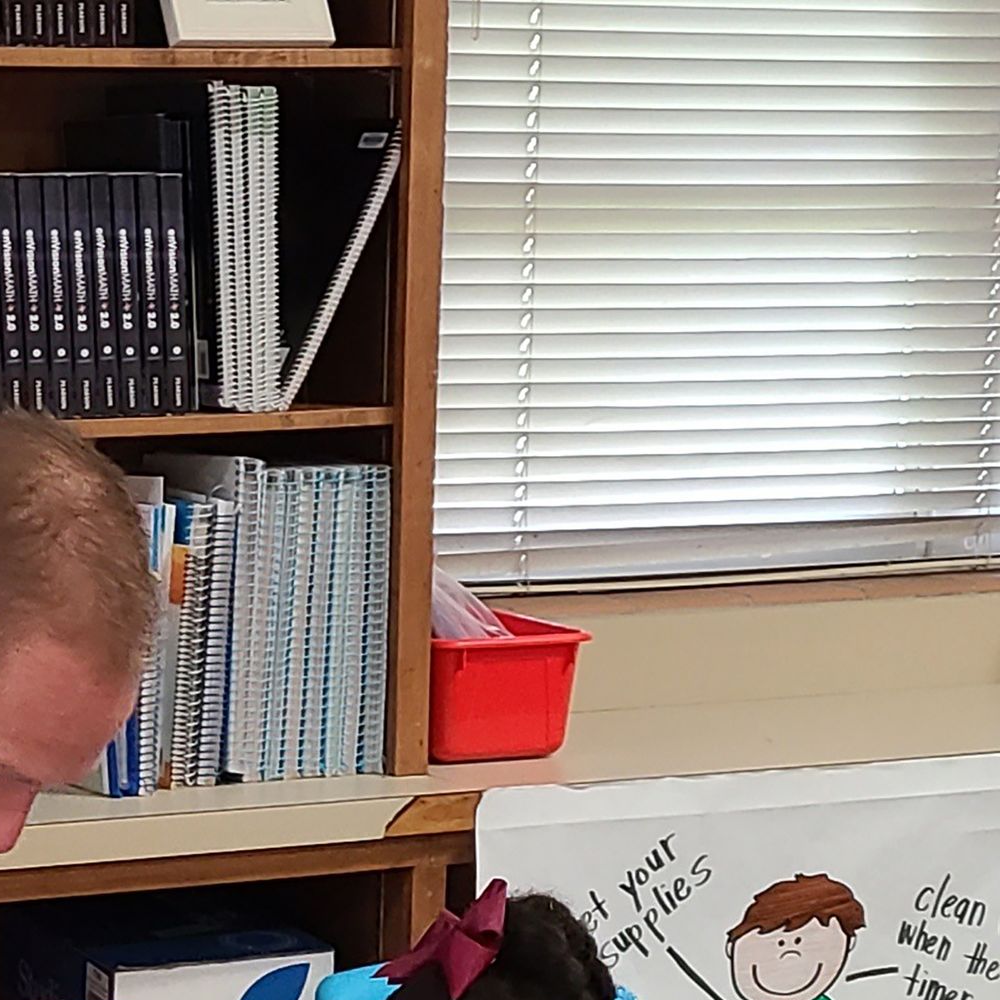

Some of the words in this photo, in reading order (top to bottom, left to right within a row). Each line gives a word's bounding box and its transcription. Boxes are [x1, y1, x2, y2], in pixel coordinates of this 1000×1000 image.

[6, 314, 17, 332] 2.0
[29, 315, 39, 331] 2.0
[54, 314, 64, 331] 2.0
[77, 314, 88, 331] 2.0
[100, 312, 110, 329] 2.0
[123, 312, 133, 330] 2.0
[147, 312, 157, 329] 2.0
[170, 312, 180, 329] 2.0
[578, 889, 610, 933] et
[618, 832, 676, 914] your
[914, 872, 987, 928] clean
[600, 853, 713, 970] supplies
[897, 919, 953, 962] when
[963, 940, 1000, 982] the
